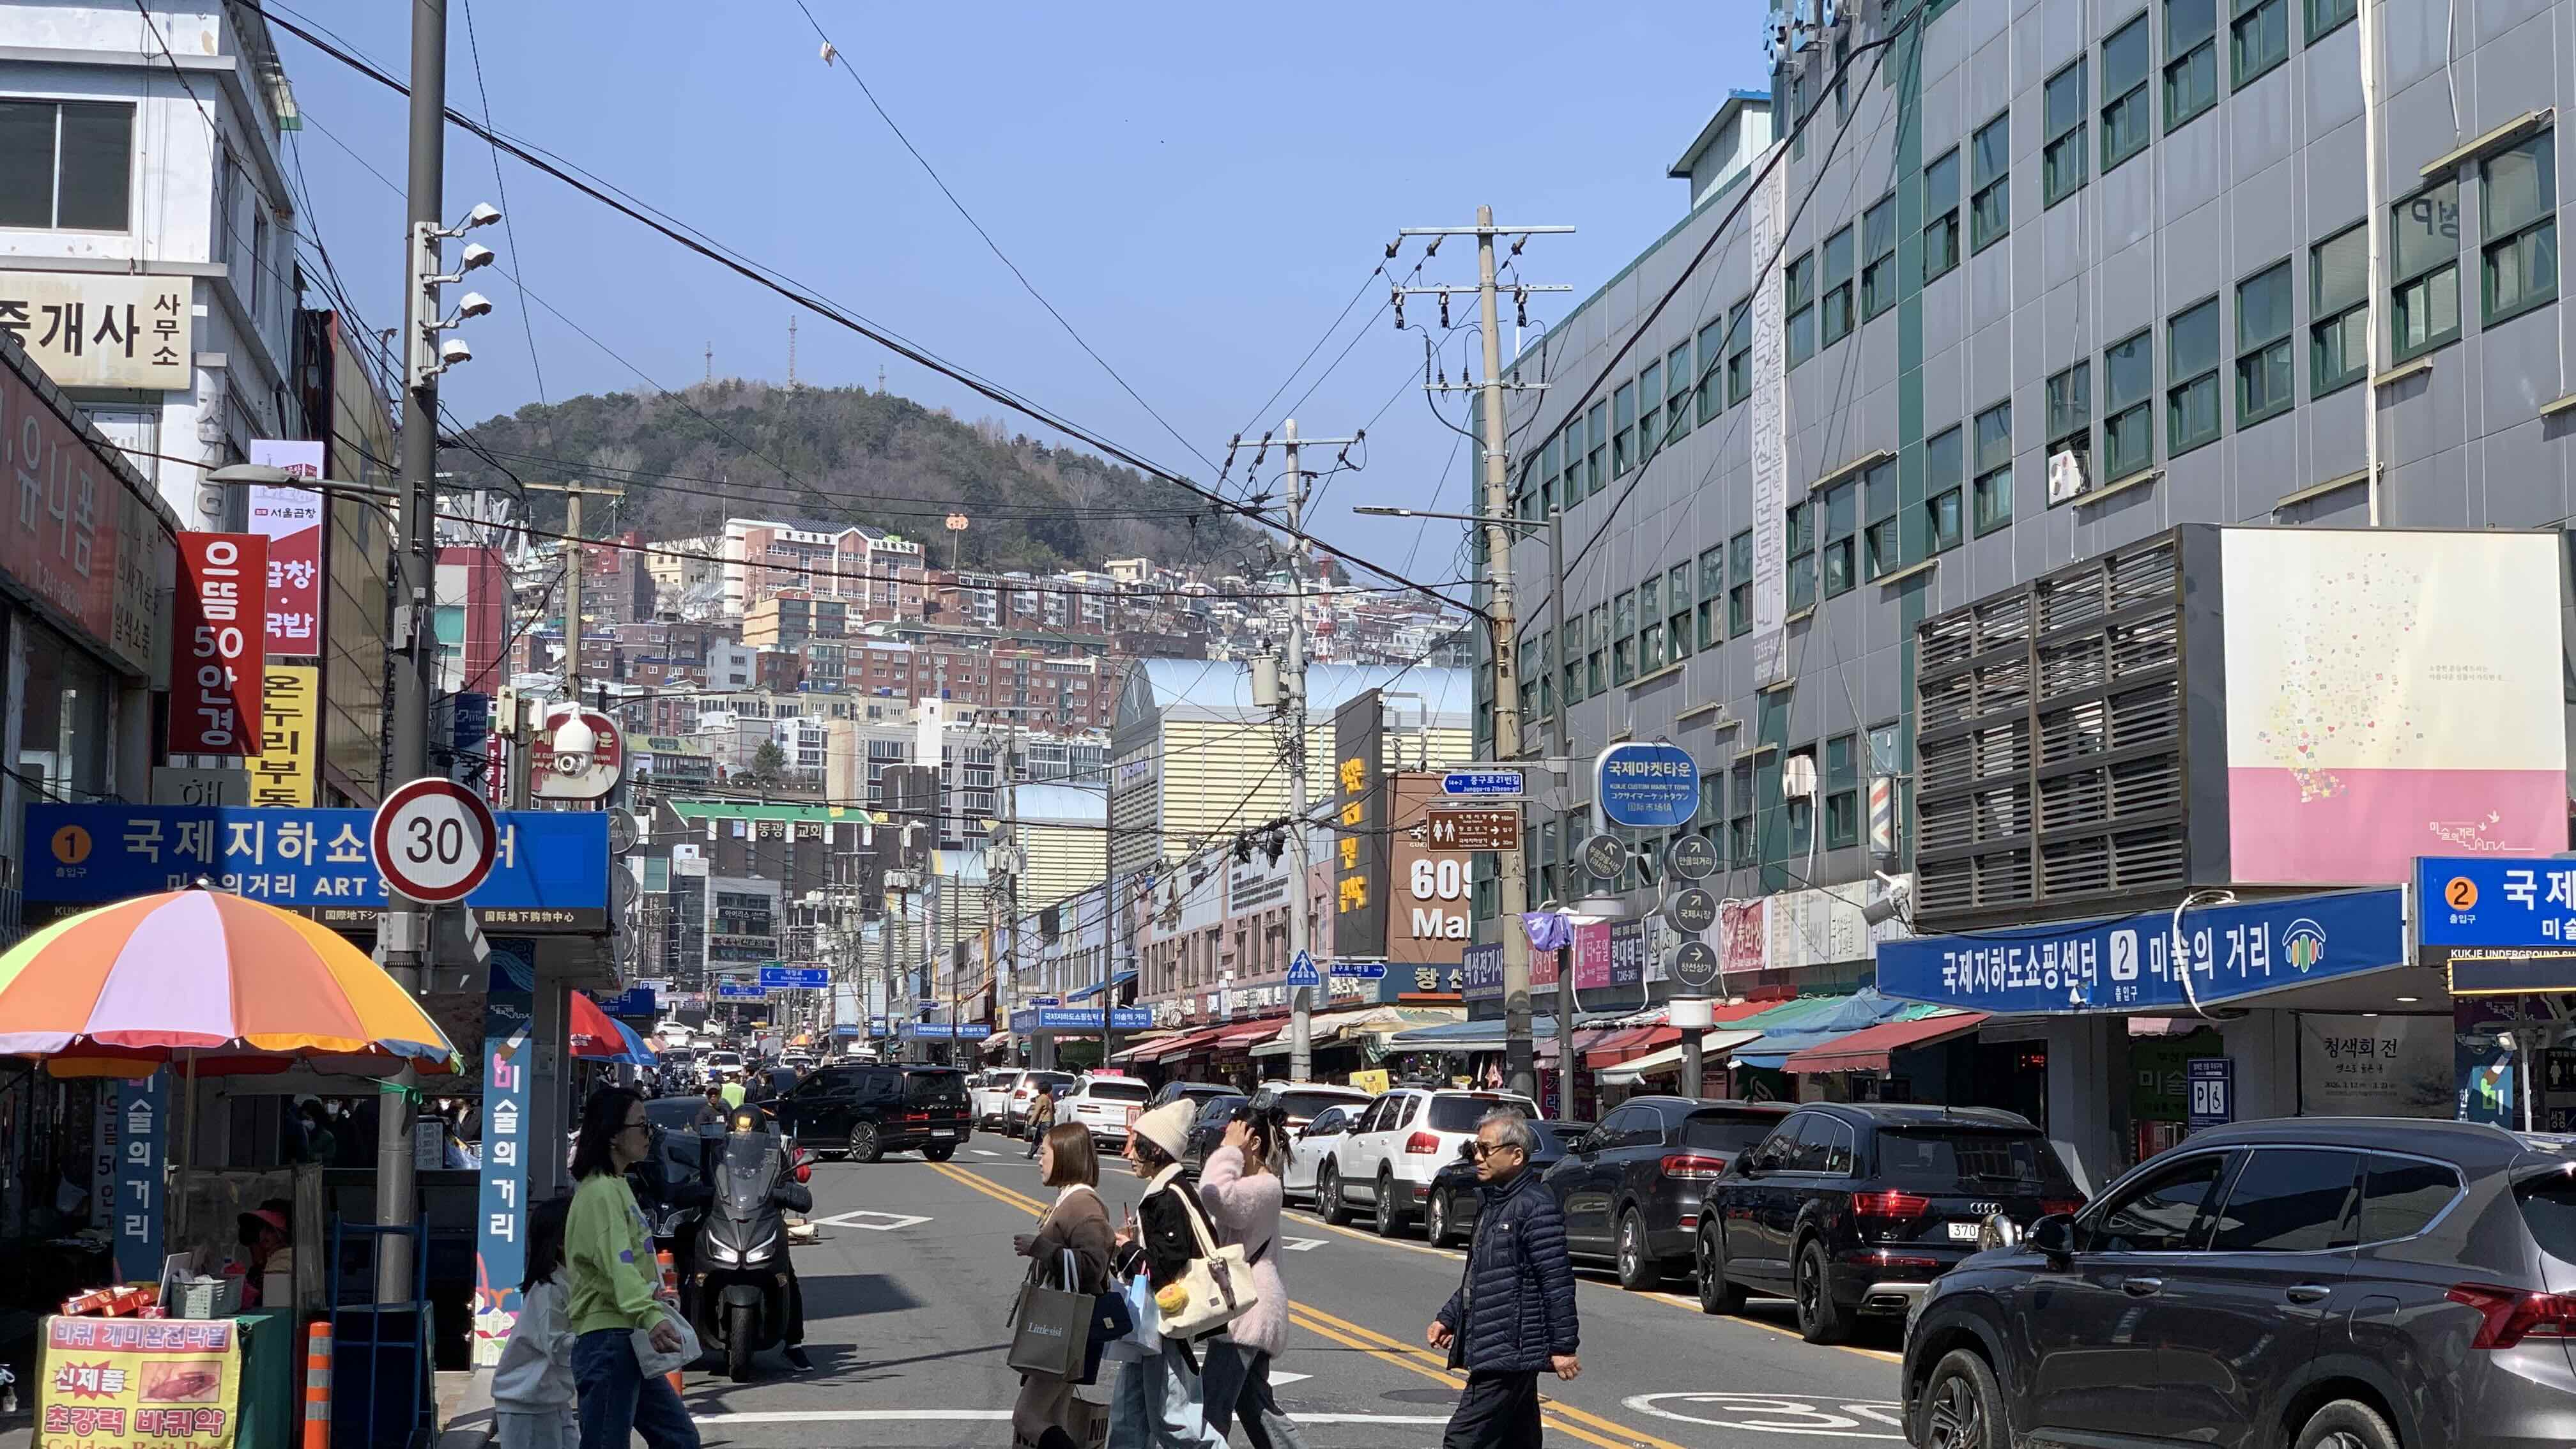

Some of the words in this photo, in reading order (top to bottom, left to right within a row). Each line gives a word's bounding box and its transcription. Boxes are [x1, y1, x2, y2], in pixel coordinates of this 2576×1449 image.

[153, 293, 181, 367] 사무소
[18, 415, 95, 579] 유니폼
[270, 507, 316, 519] 서울곱창
[1608, 761, 1692, 777] 국제마켓타운
[406, 816, 463, 864] 30
[758, 822, 785, 838] 동광
[797, 824, 822, 839] 교회
[65, 832, 75, 857] 1
[123, 820, 515, 870] 국제지하쇼터
[56, 867, 87, 878] 출입구
[167, 873, 296, 897] 미의거리
[314, 878, 367, 896] ART
[2453, 882, 2469, 905] 2
[485, 910, 574, 923] 国际地下购物中心
[1680, 908, 1711, 919] 국제시장
[2450, 914, 2476, 924] 출입구
[2118, 935, 2130, 973] 2
[2150, 926, 2214, 983] 미술의
[2227, 921, 2271, 977] 거리
[2451, 949, 2483, 959] KUKJE
[2485, 949, 2561, 959] UNDERGROUND
[1681, 962, 1712, 973] 창선상가
[1942, 937, 2098, 995] 국제지하도쇼핑센터
[2115, 986, 2138, 1002] 출입구
[2324, 1038, 2375, 1058] 청색회
[2380, 1038, 2398, 1058] 전
[55, 1321, 95, 1345] 바퀴
[102, 1324, 226, 1348] 개미완전박멸
[55, 1367, 126, 1392] 신제품
[44, 1405, 126, 1437] 초강력
[134, 1407, 226, 1437] 바퀴약
